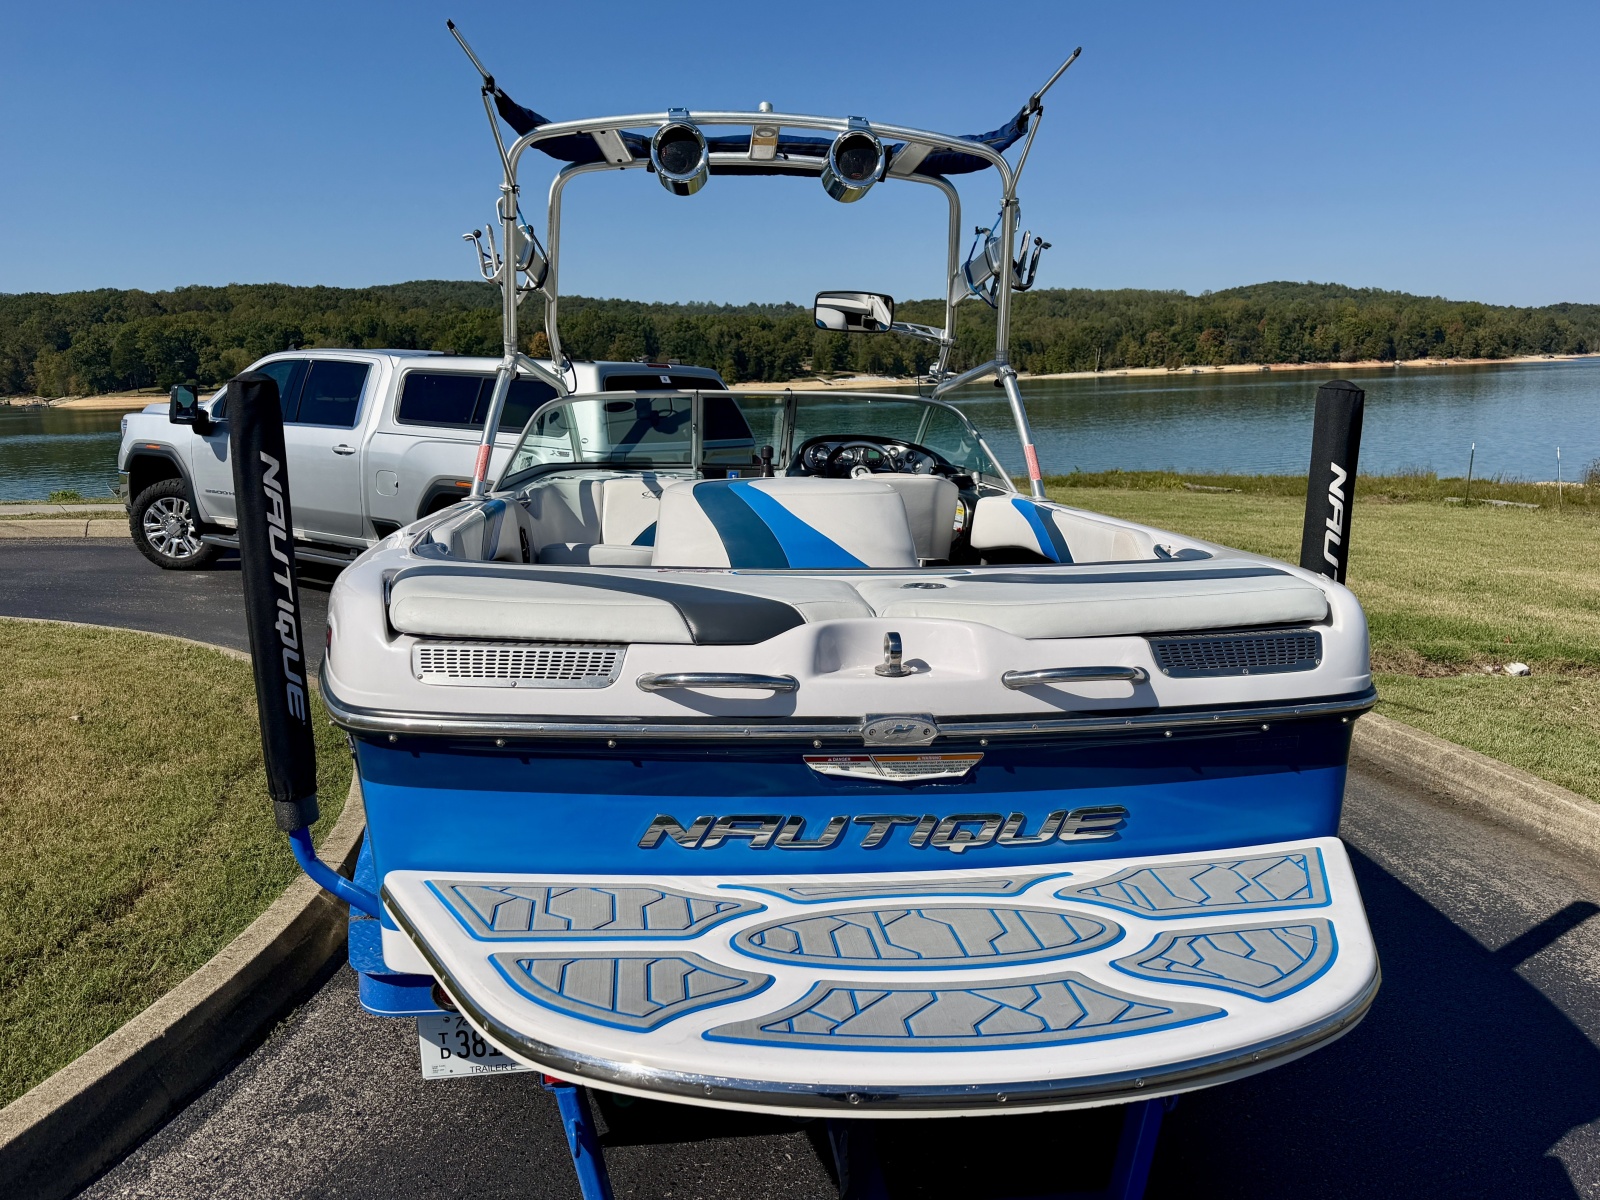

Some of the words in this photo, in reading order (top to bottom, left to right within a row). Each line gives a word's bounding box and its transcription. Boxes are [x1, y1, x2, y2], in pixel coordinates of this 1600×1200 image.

[1323, 461, 1348, 581] NAU
[259, 450, 306, 721] NAUTIQUE
[637, 804, 1127, 854] NAUTIQUE
[470, 1063, 508, 1074] TRAILER
